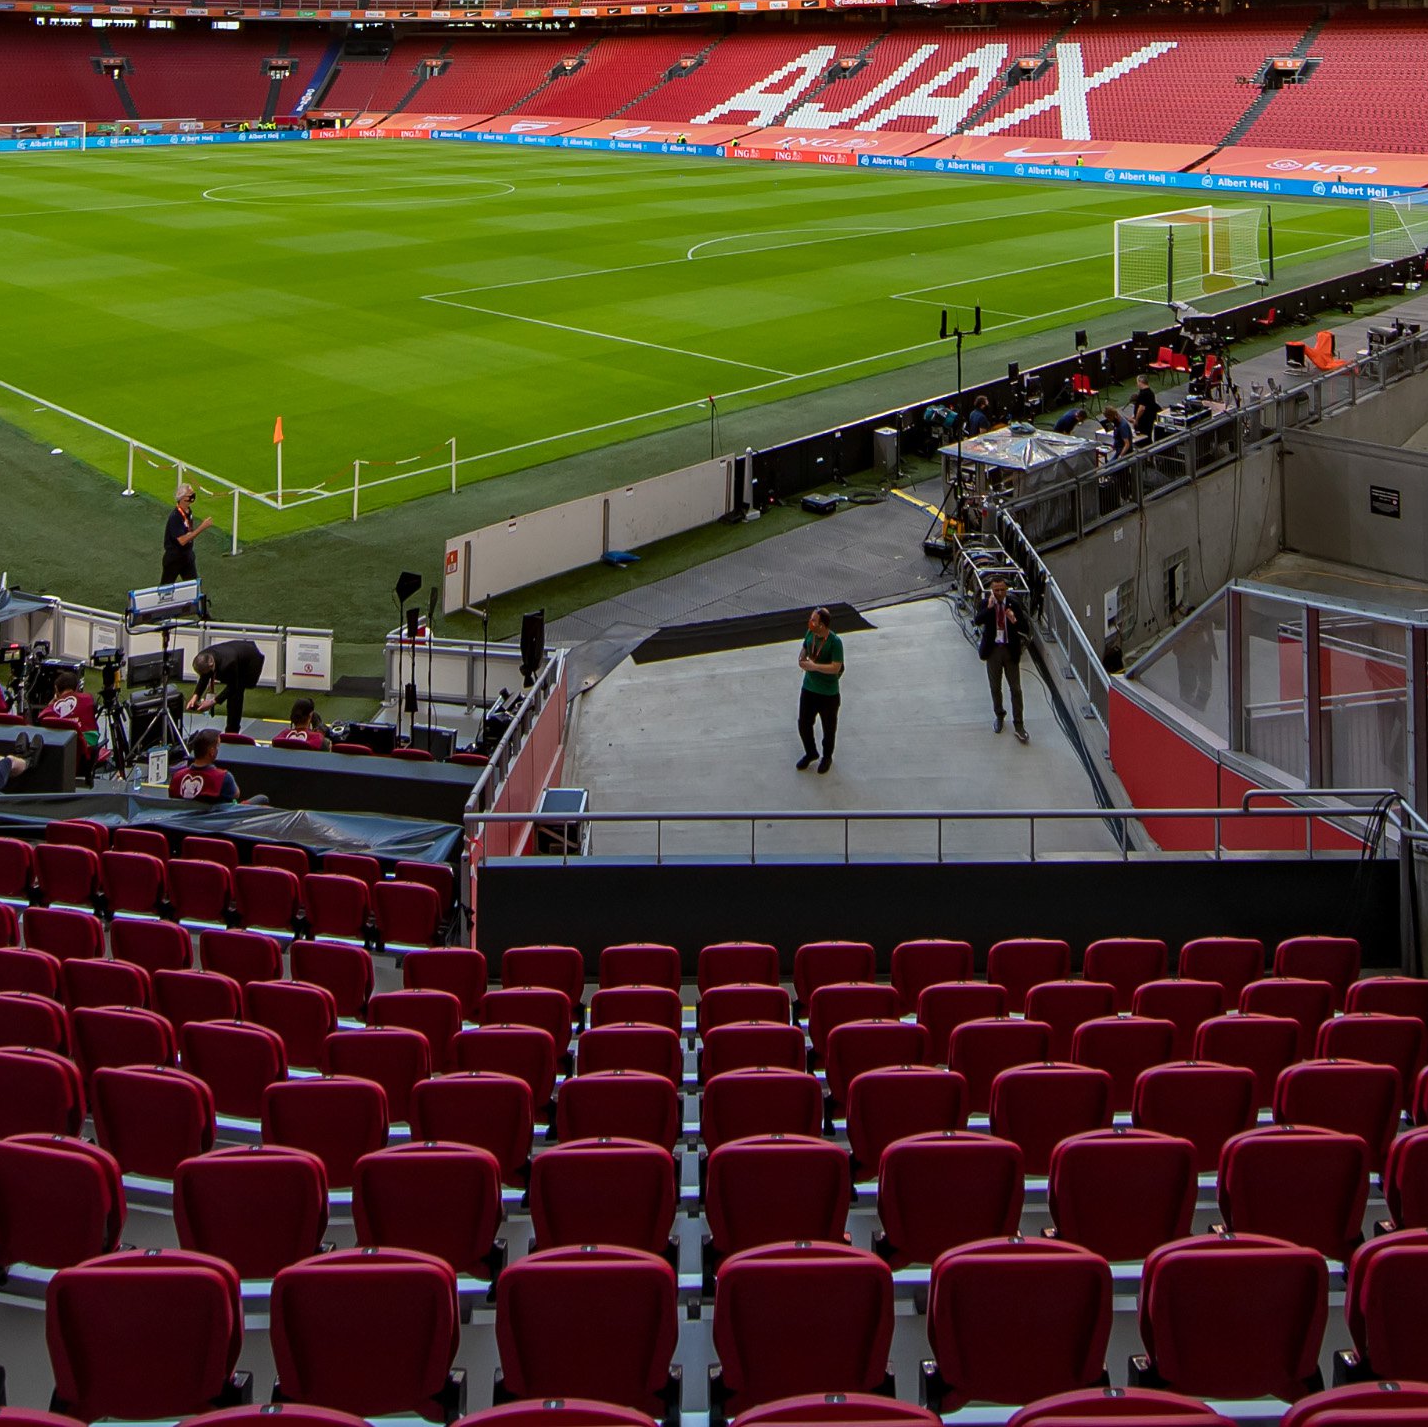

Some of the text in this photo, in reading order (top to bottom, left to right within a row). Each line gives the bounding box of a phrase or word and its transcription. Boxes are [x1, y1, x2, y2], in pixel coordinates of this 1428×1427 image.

[690, 41, 1179, 141] AJAX
[400, 130, 415, 138] ING
[29, 139, 52, 147] Albert
[774, 136, 842, 148] ING
[734, 149, 750, 158] ING
[774, 151, 791, 160] ING
[818, 153, 836, 163] ING
[872, 157, 892, 166] Albert
[947, 161, 969, 170] Albert
[1028, 166, 1052, 175] Albert
[1302, 161, 1378, 175] kpn
[1119, 172, 1146, 182] Albert
[1217, 177, 1248, 188] Albert
[1331, 184, 1364, 196] Albert
